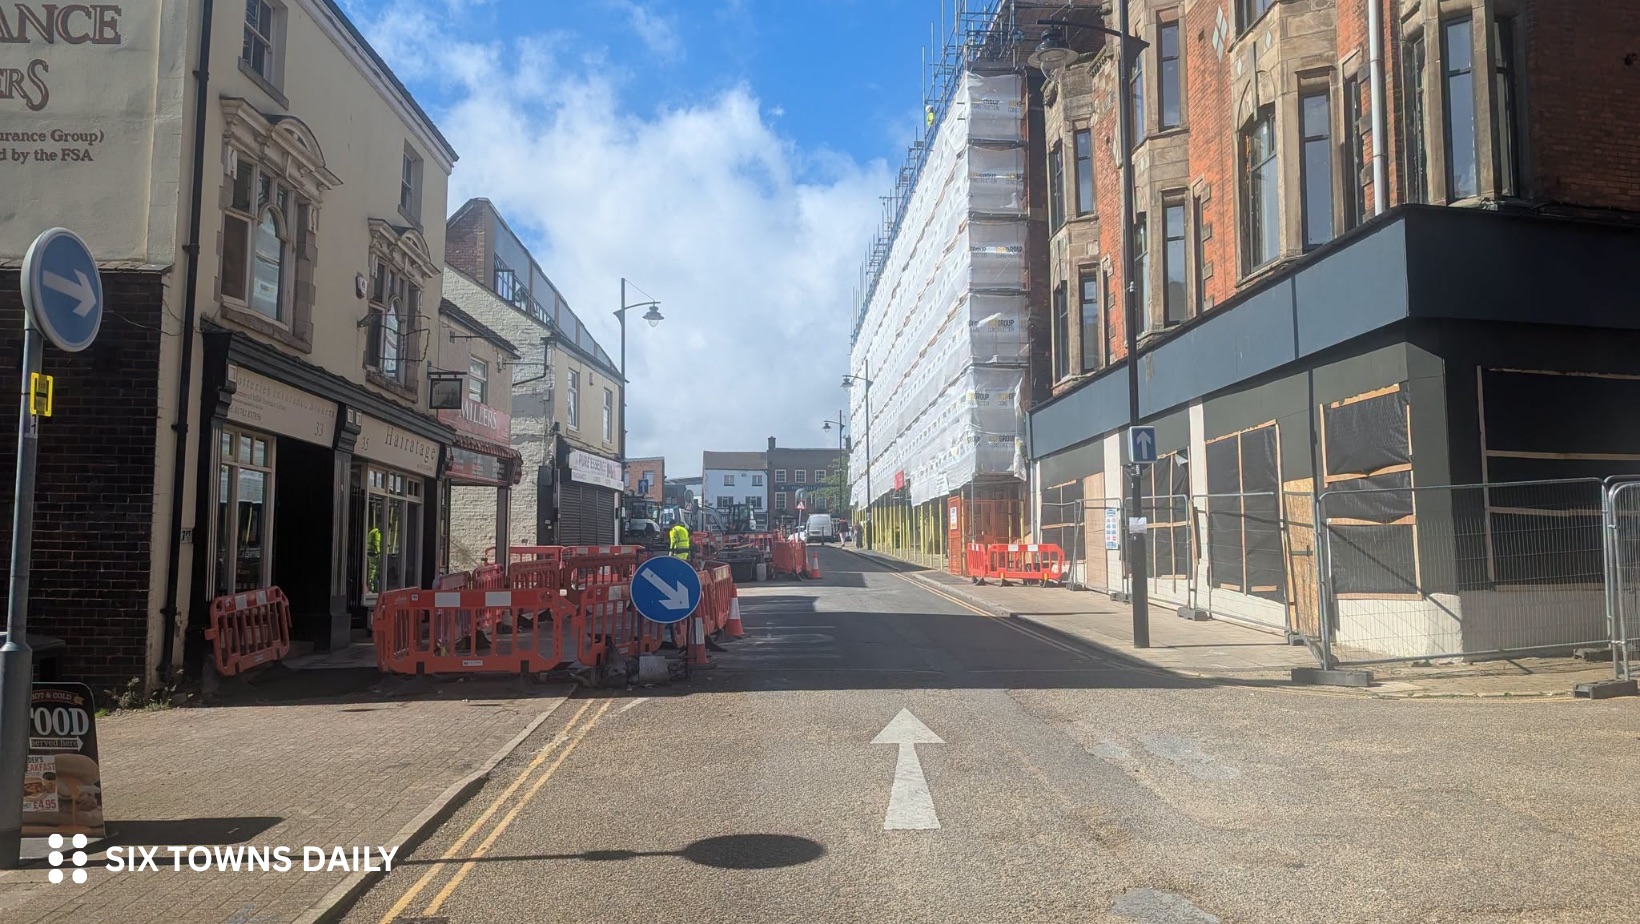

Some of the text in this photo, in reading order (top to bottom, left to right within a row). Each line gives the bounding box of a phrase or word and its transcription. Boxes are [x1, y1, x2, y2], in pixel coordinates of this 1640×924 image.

[50, 129, 105, 146] Group)
[11, 148, 30, 165] by
[33, 148, 58, 161] the
[61, 148, 94, 161] FSA
[459, 399, 497, 430] MILLERS
[314, 421, 324, 437] 33
[385, 425, 436, 463] Hairatage
[31, 707, 89, 736] OOD
[33, 799, 57, 810] £4.95
